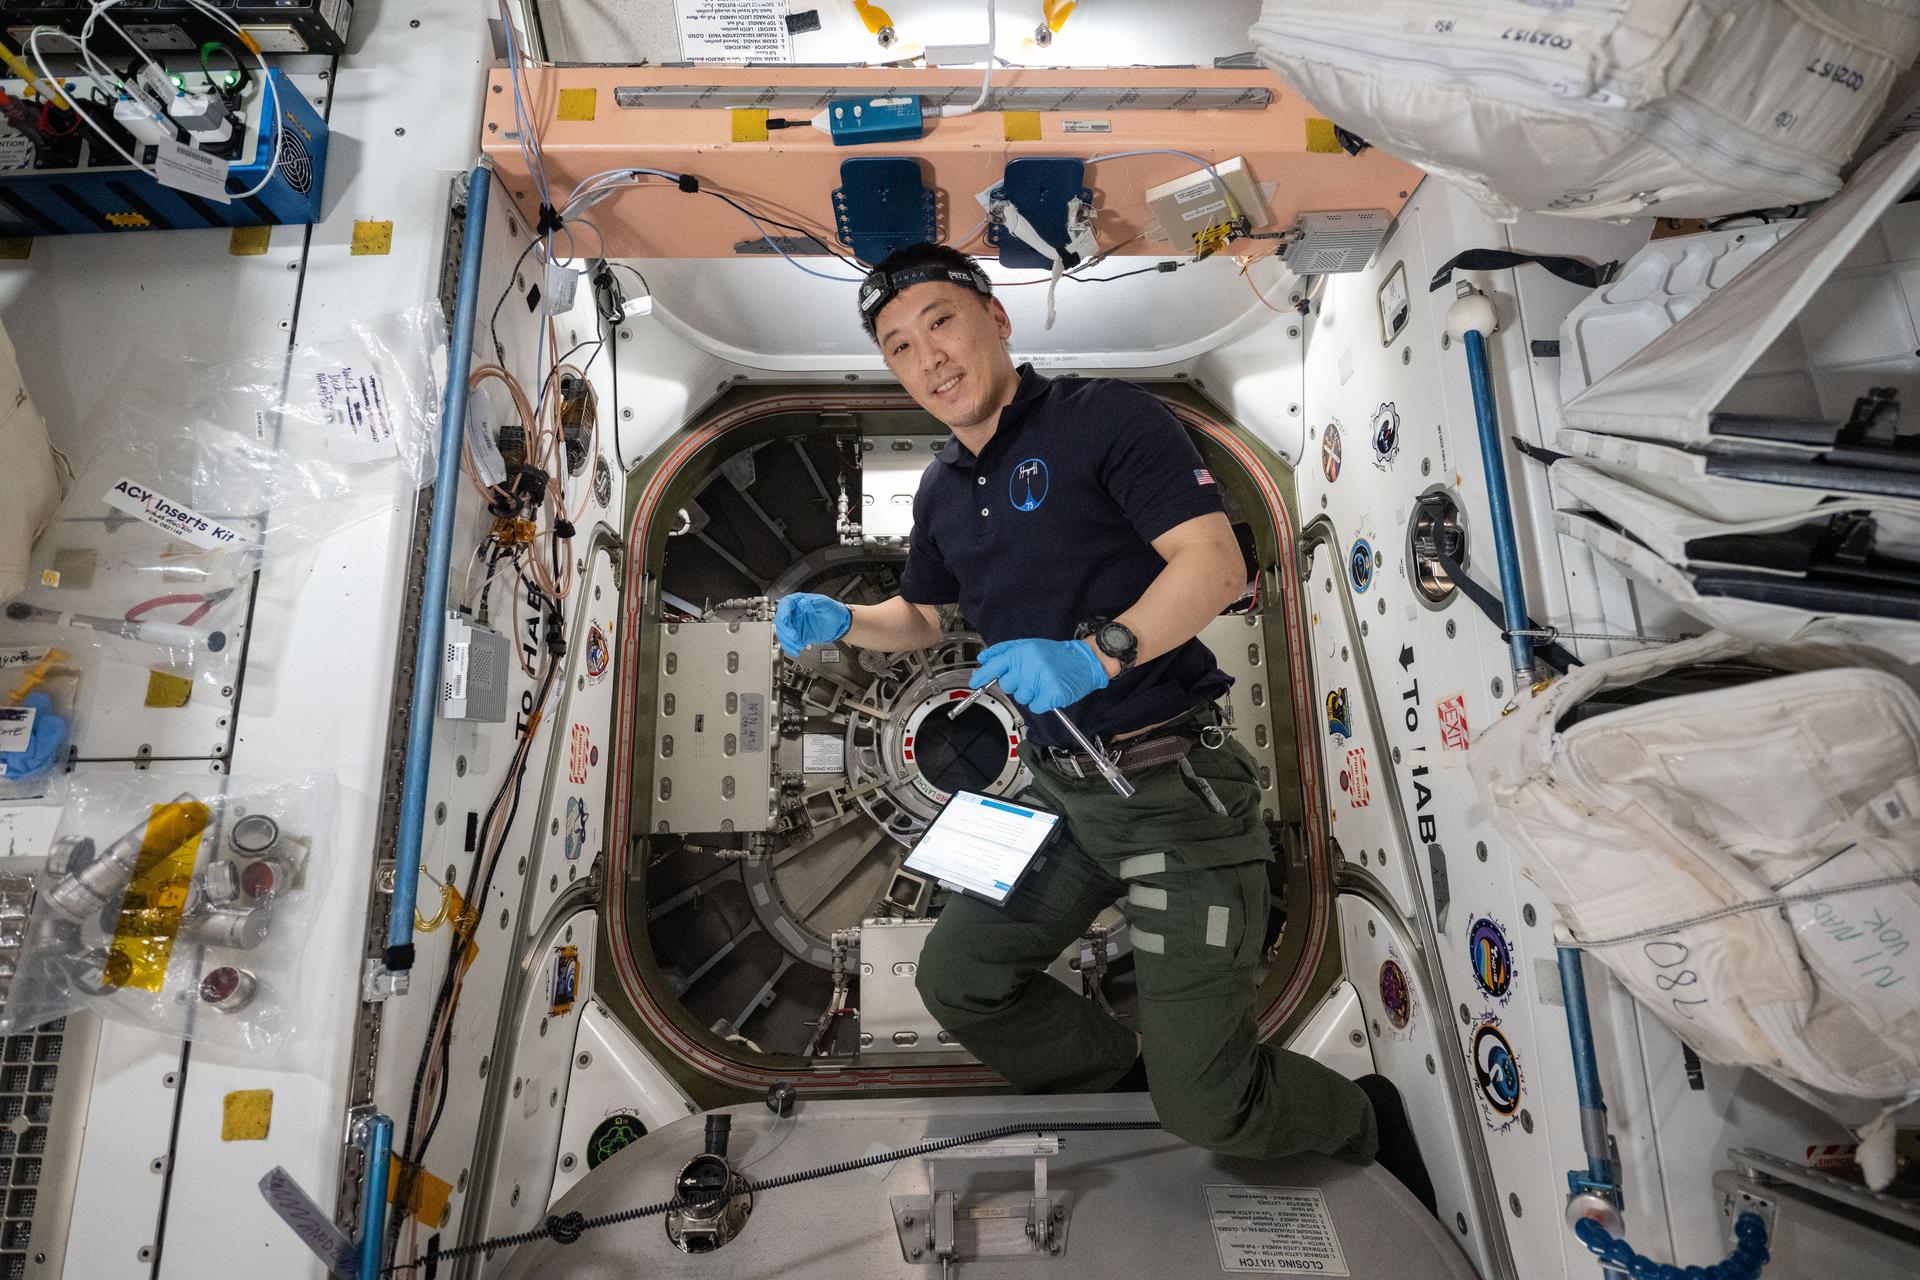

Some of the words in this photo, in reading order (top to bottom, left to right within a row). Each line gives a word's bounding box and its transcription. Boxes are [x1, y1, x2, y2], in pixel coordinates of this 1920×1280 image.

[948, 271, 973, 281] PETZL
[114, 481, 152, 502] ACY
[155, 499, 208, 532] Inserts
[212, 526, 235, 542] Kit
[521, 581, 543, 675] HAB
[1444, 711, 1463, 750] EXIT
[1351, 756, 1360, 775] FIRE
[914, 775, 936, 796] LATCHED
[1354, 776, 1363, 799] PORT
[1644, 941, 1707, 1019] 780
[1239, 1258, 1275, 1268] HATCH
[1277, 1259, 1323, 1270] CLOSING
